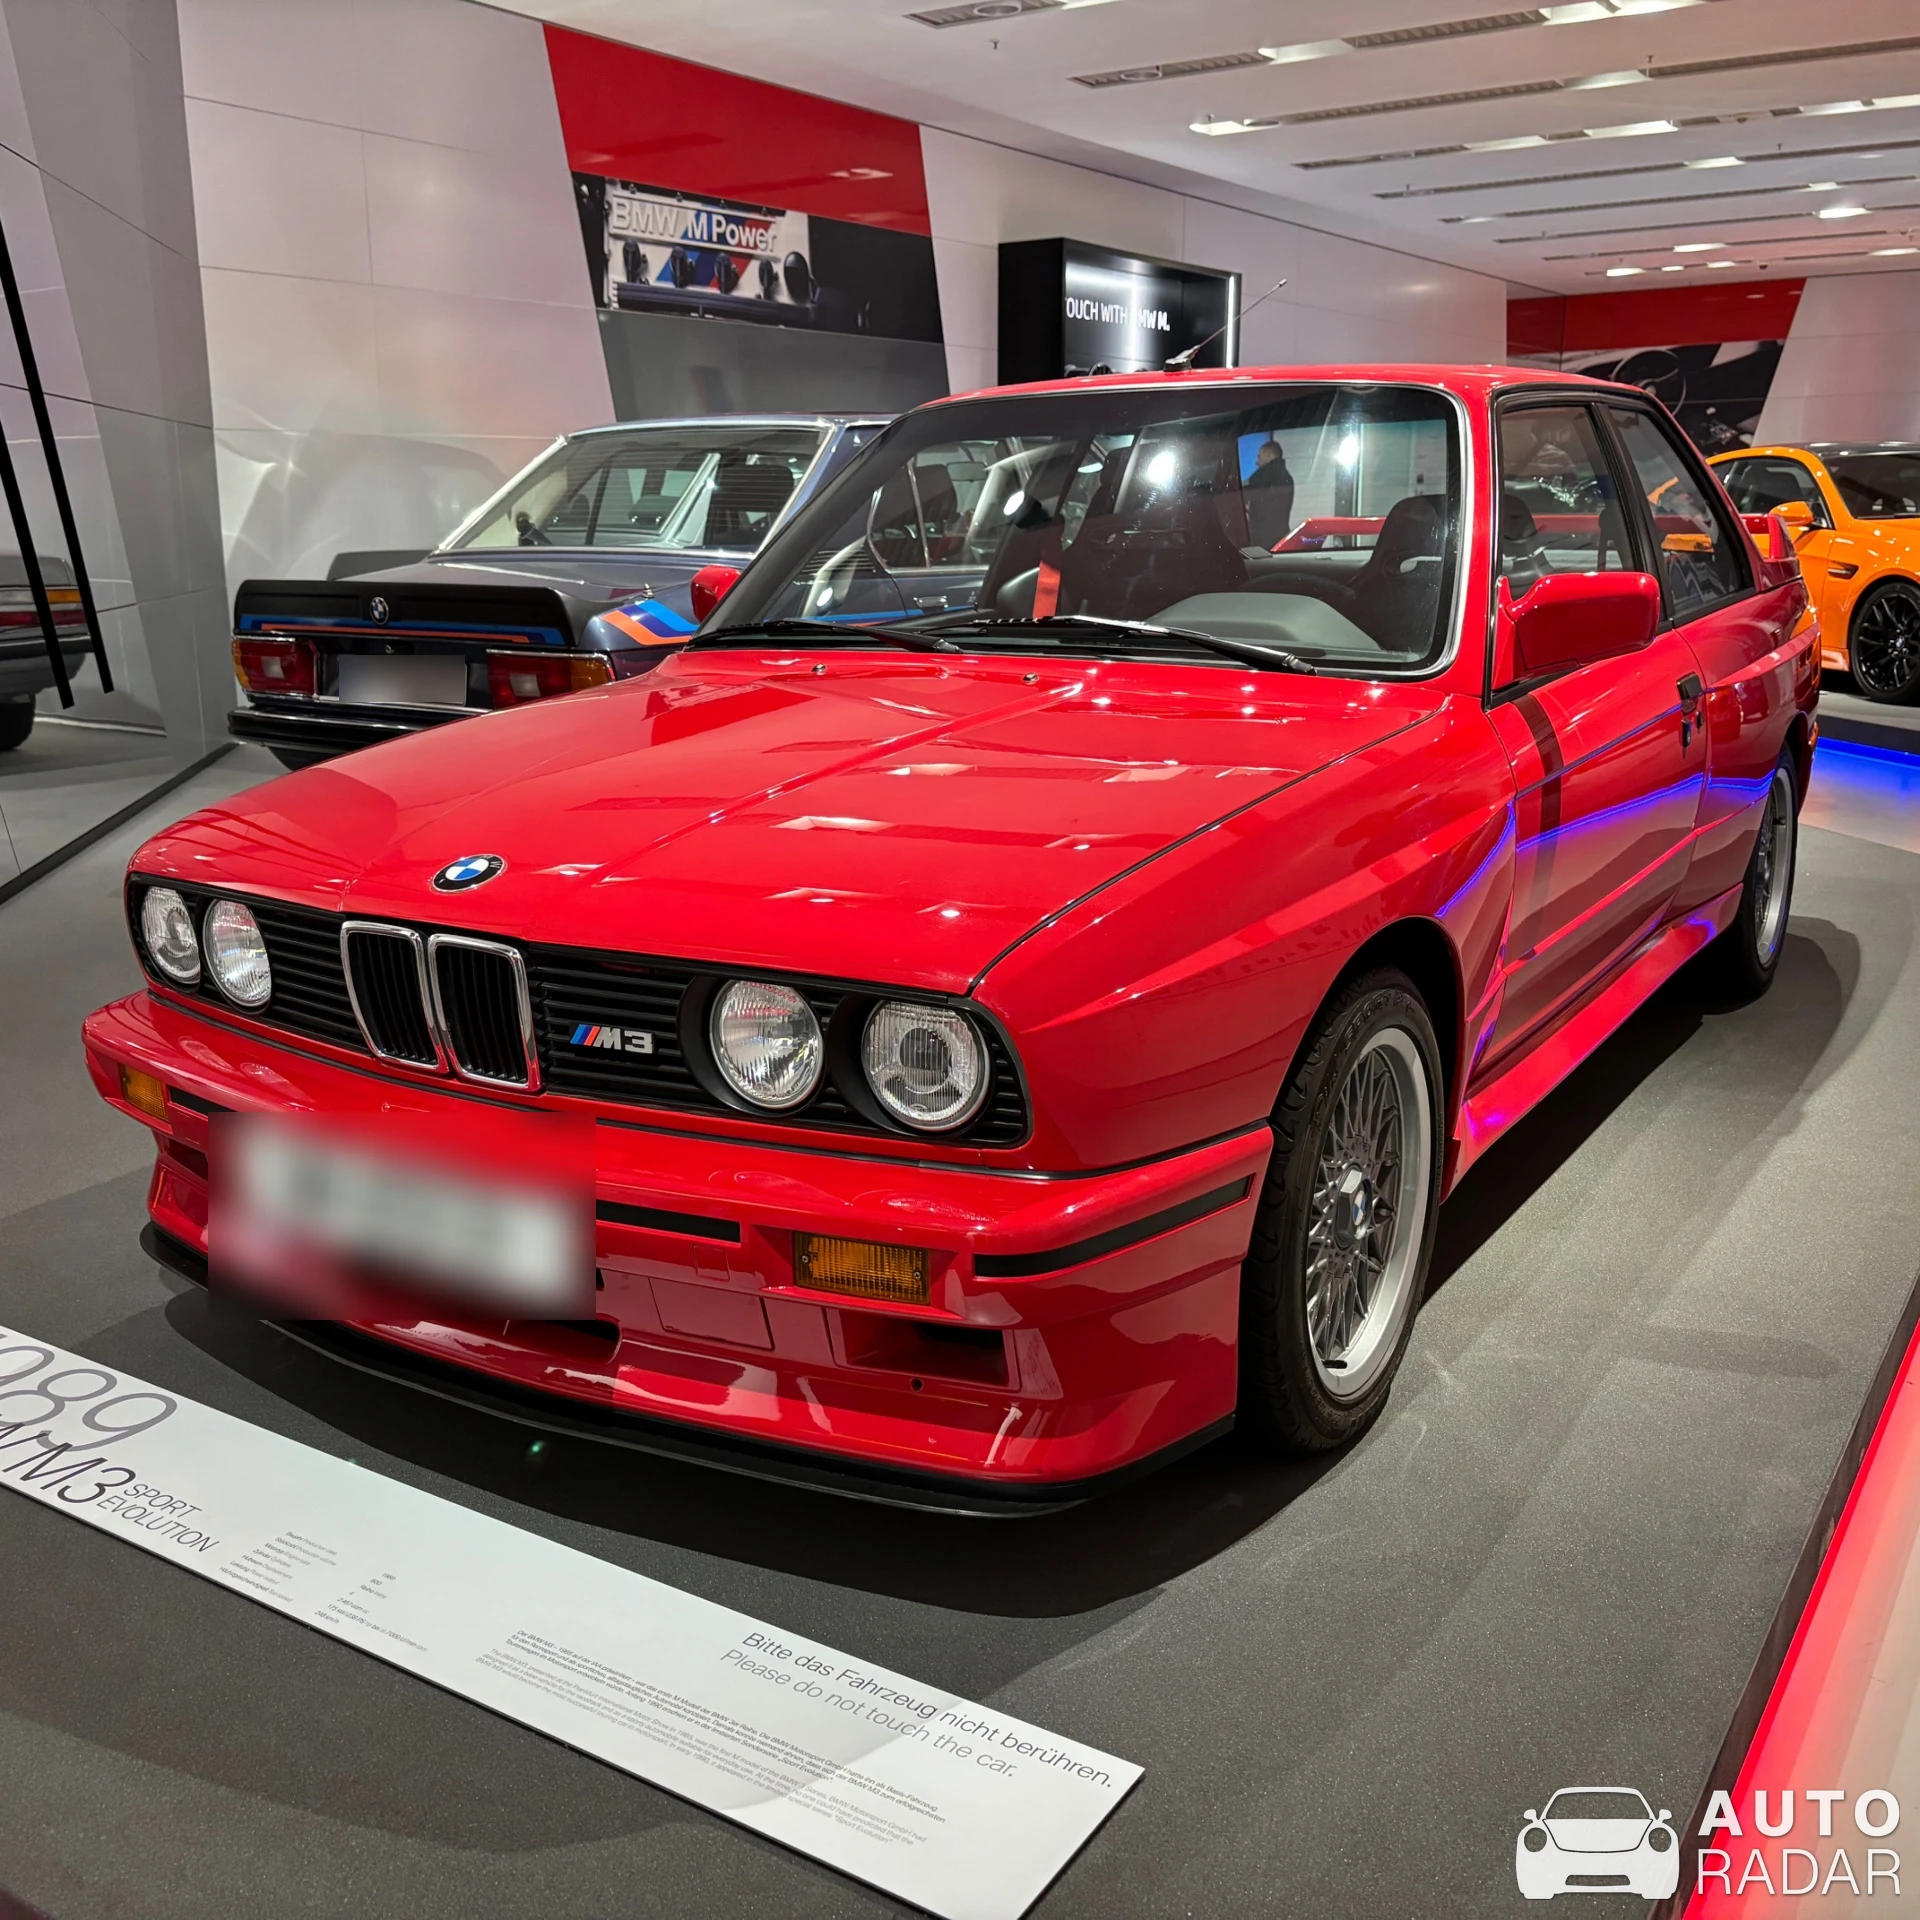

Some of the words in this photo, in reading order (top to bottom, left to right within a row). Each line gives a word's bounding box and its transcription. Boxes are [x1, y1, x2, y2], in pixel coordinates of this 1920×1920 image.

[612, 200, 680, 238] BMW
[687, 208, 709, 241] M
[711, 213, 777, 253] Power
[1065, 296, 1099, 322] OUCH
[1100, 302, 1128, 325] WITH
[592, 1026, 655, 1055] M3
[1, 1441, 137, 1504] M3
[123, 1483, 203, 1518] SPORT
[96, 1494, 220, 1553] EVOLUTION
[720, 1649, 791, 1684] Please
[793, 1681, 823, 1697] do
[824, 1694, 865, 1715] not
[866, 1707, 930, 1741] touch
[933, 1734, 972, 1758] the
[977, 1754, 1017, 1776] car.
[742, 1633, 792, 1659] Bitte
[795, 1656, 834, 1676] das
[835, 1669, 938, 1719] Fahrzeug
[939, 1713, 999, 1741] nicht
[1000, 1732, 1111, 1787] berühren.
